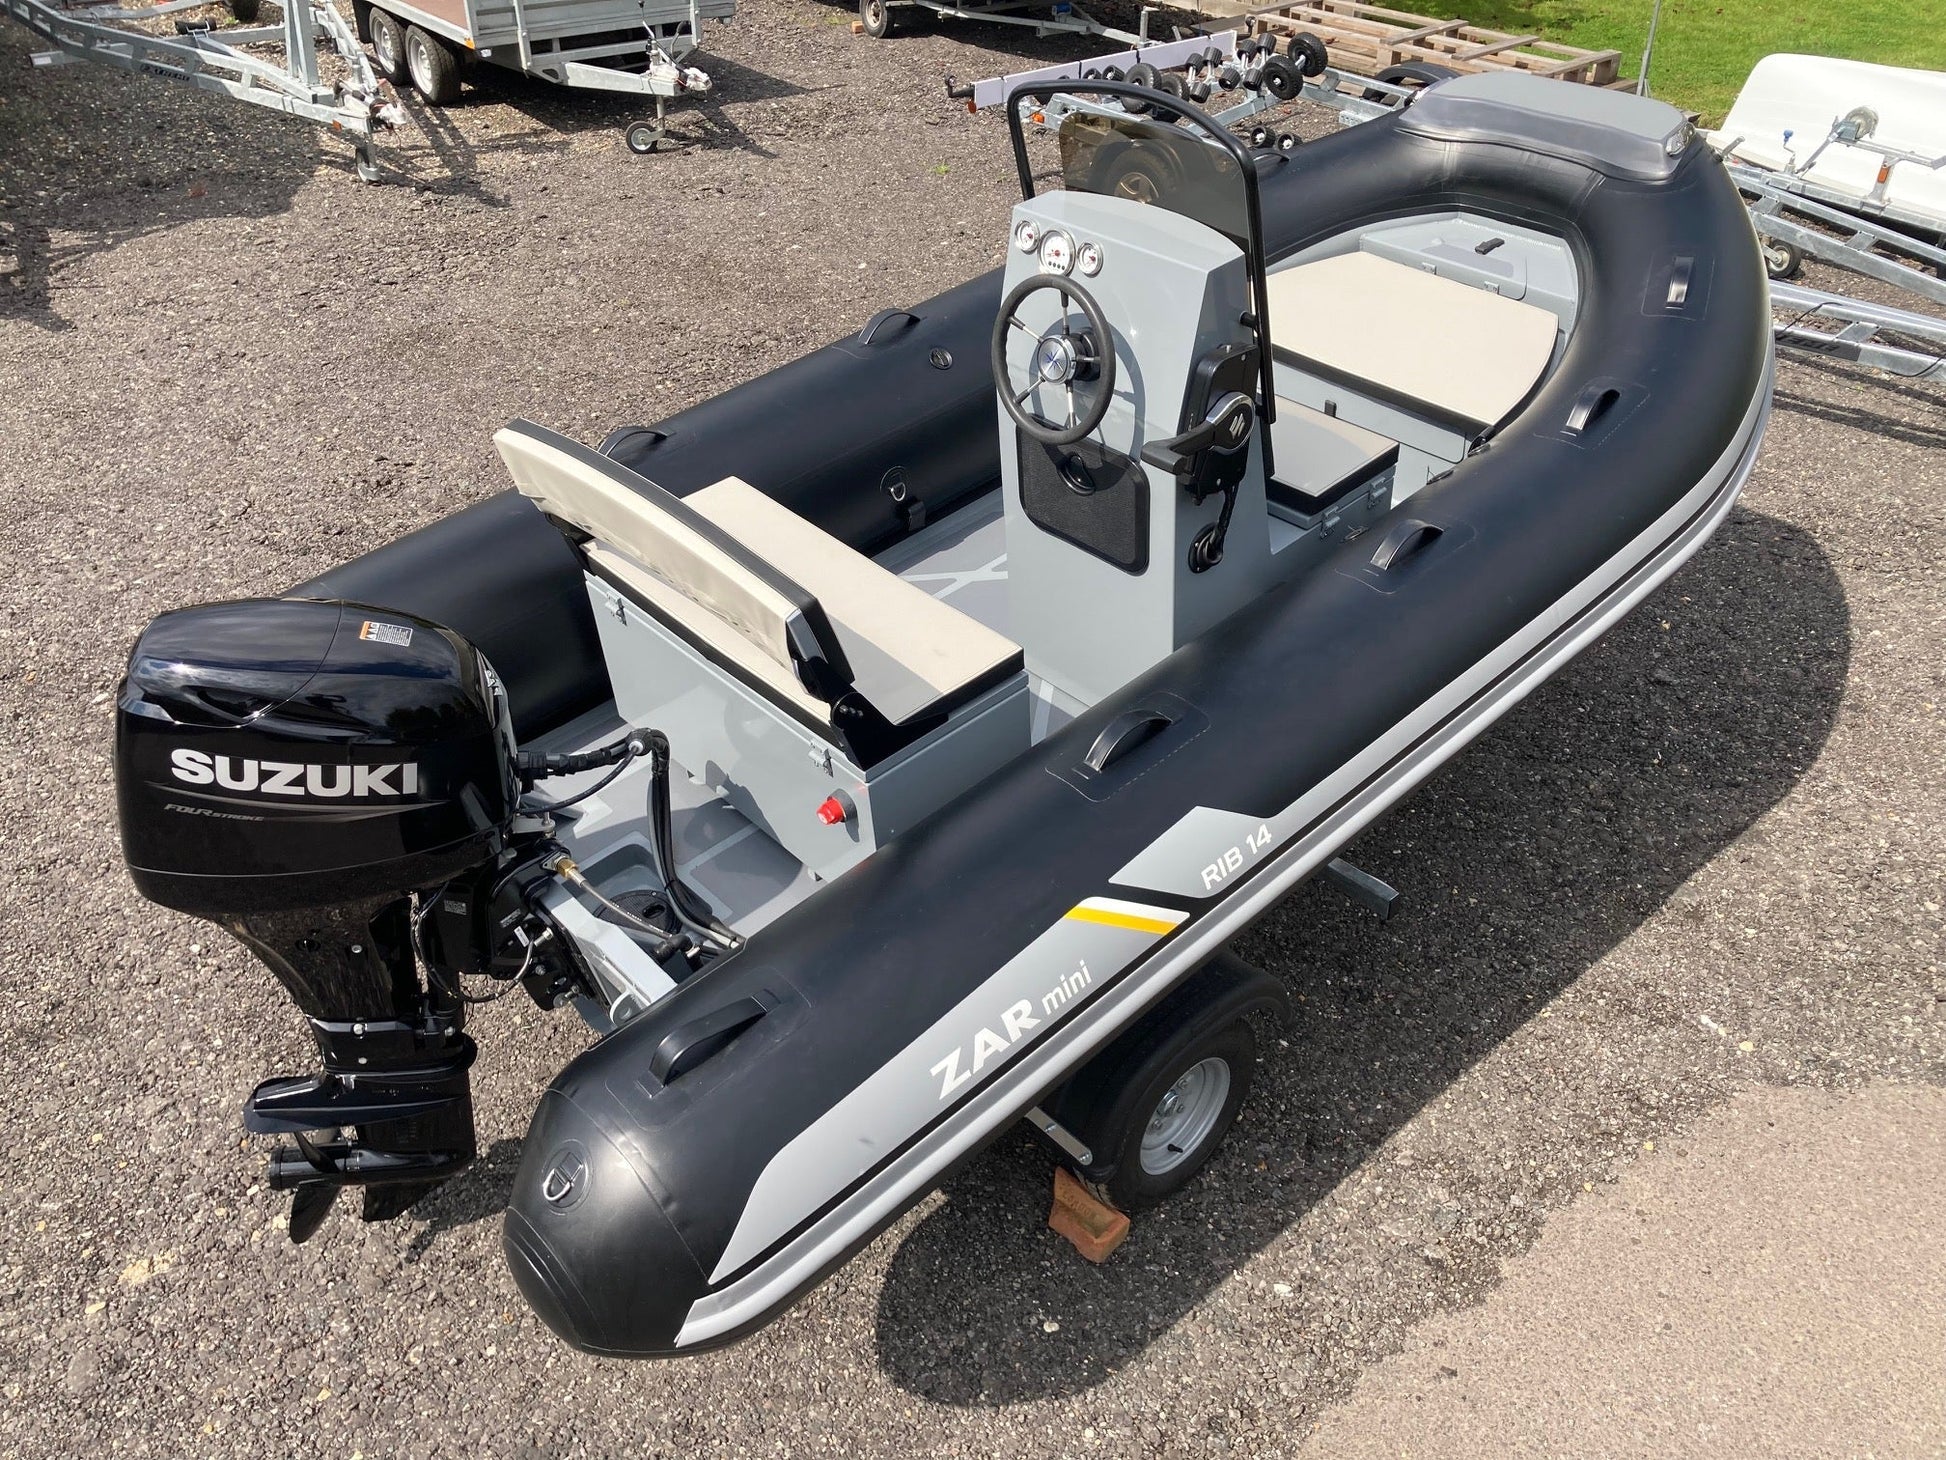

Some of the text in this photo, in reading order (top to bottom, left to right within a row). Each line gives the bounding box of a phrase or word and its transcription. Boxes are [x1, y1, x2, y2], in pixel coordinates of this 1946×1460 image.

[171, 748, 418, 798] SUZUKI
[1201, 824, 1272, 890] RIB 14
[930, 959, 1092, 1100] ZAR mini
